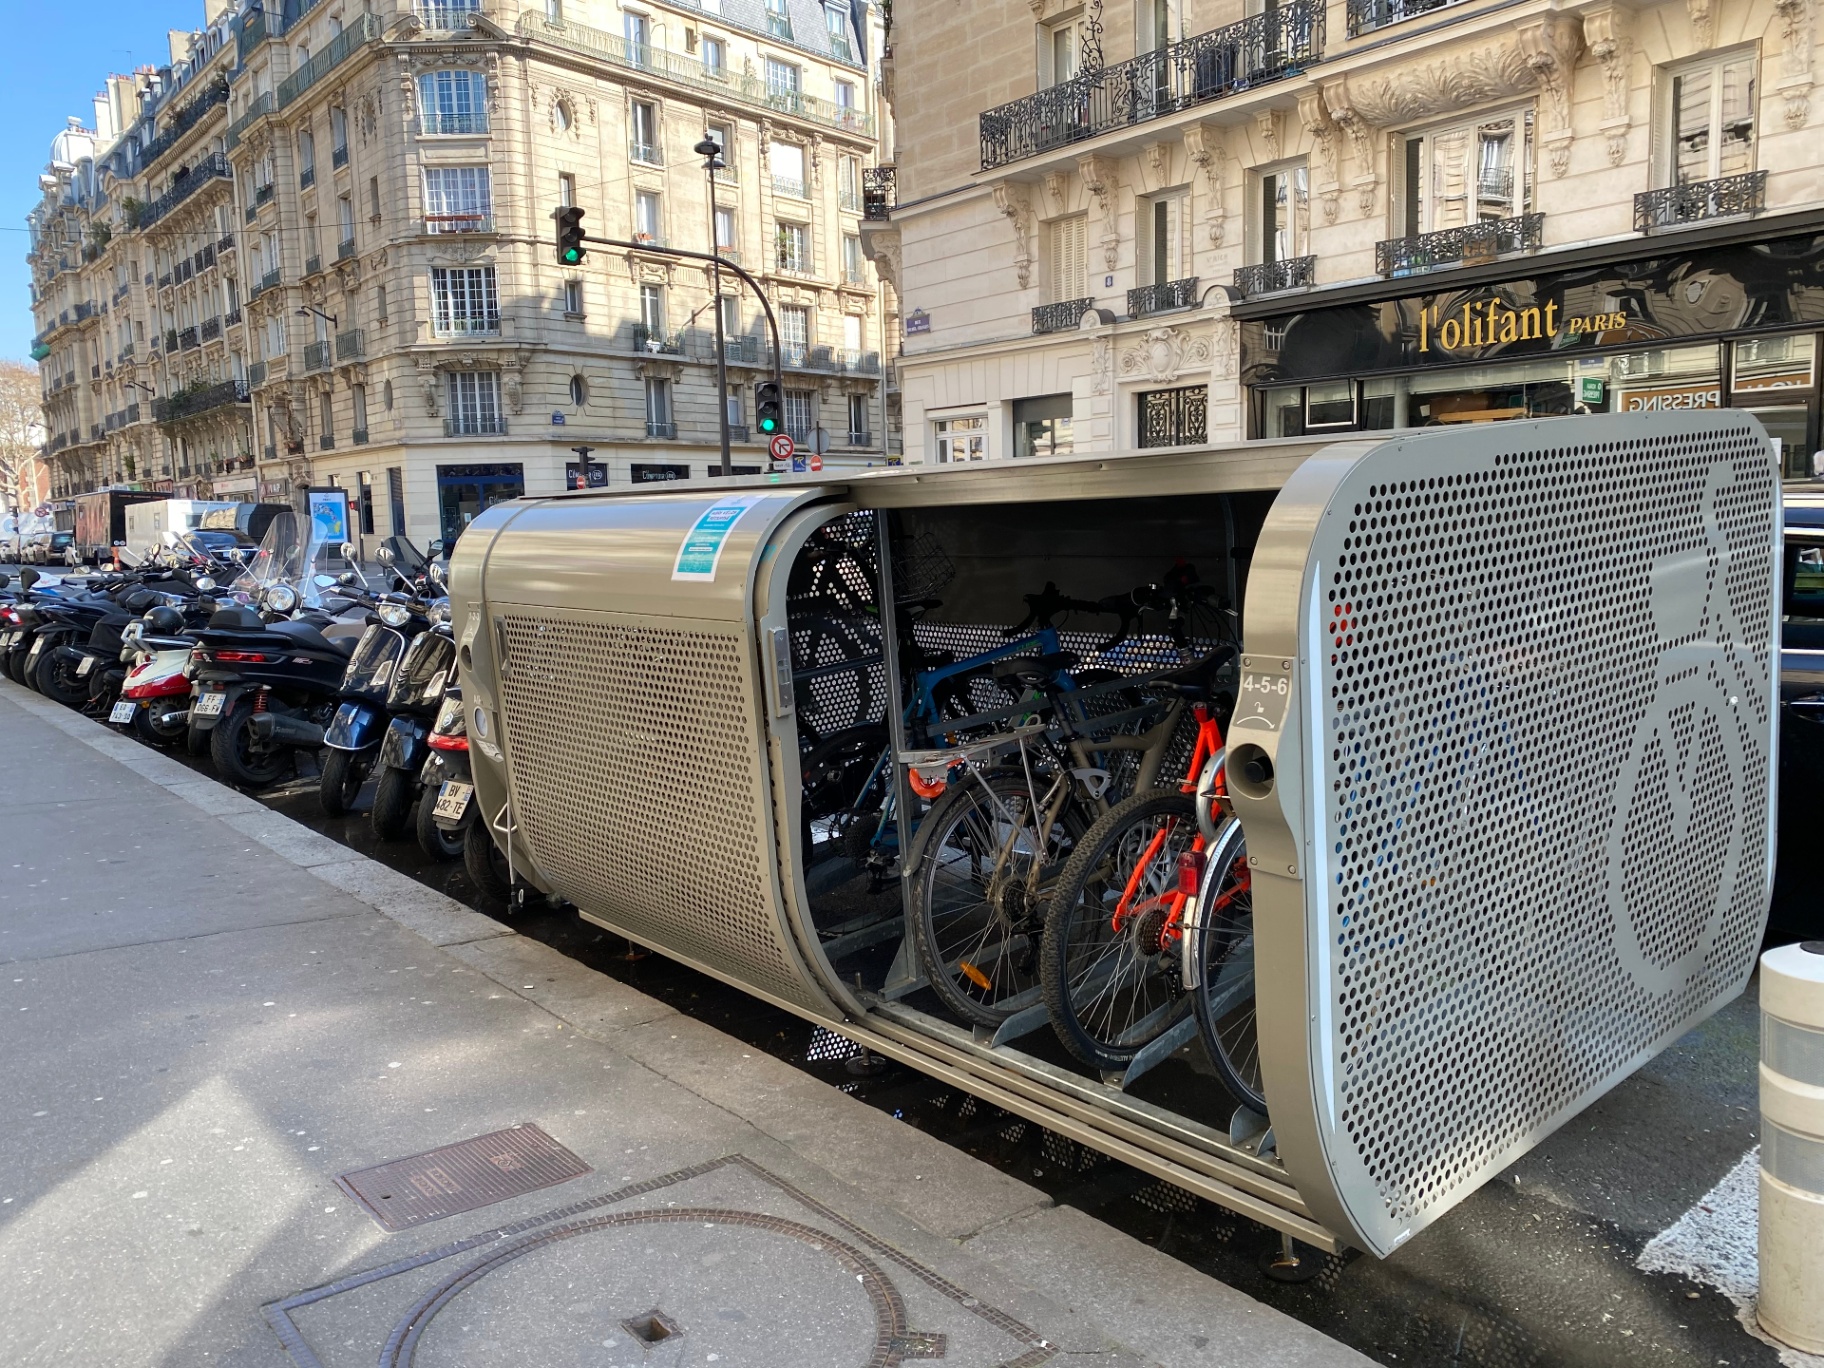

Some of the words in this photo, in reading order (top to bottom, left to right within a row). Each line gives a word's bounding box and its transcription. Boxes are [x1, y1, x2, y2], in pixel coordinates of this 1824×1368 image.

[1419, 298, 1558, 352] l'olifant
[1569, 311, 1627, 334] PARIS
[1243, 674, 1288, 696] 4-5-6
